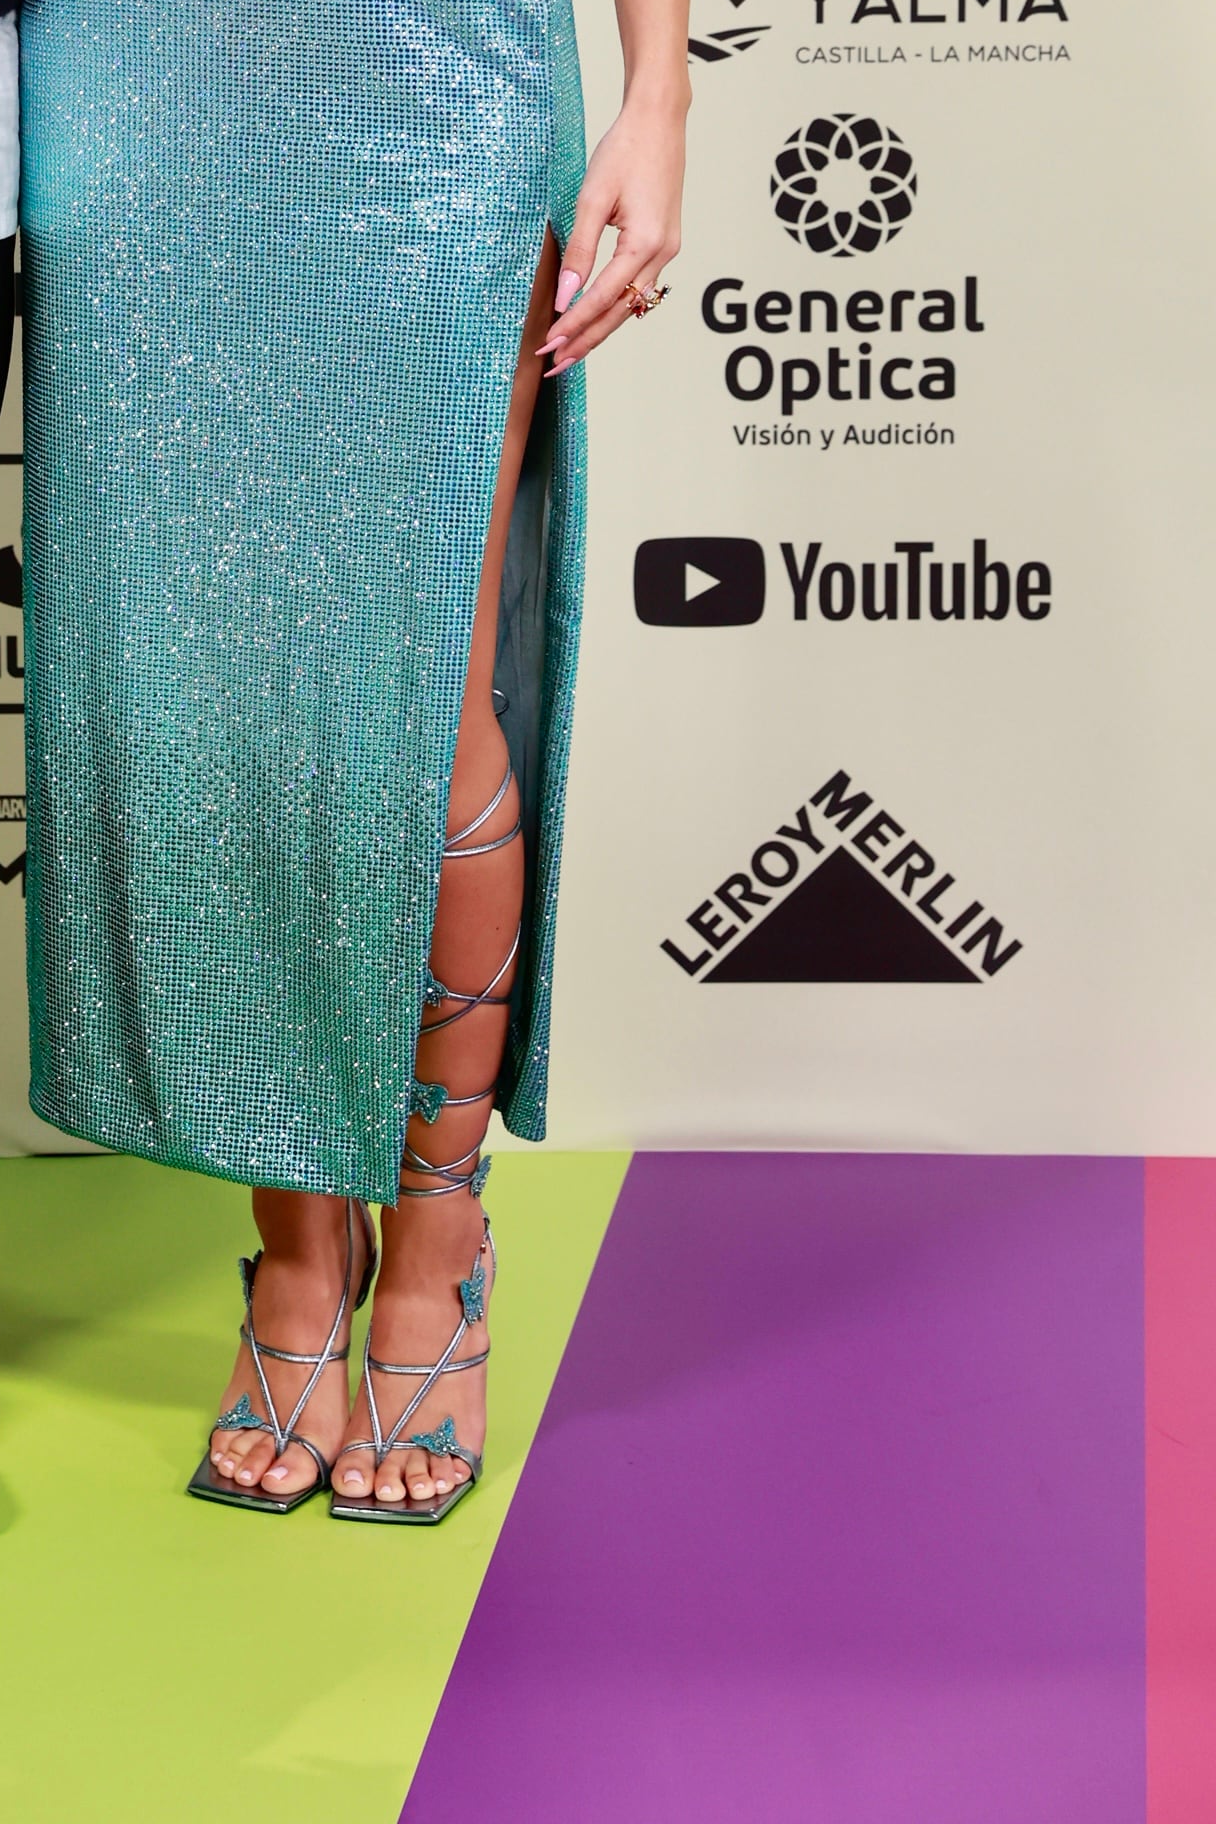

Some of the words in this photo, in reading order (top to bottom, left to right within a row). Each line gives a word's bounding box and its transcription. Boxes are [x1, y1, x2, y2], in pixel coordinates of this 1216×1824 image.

[795, 46, 907, 64] CASTILLA
[930, 46, 960, 63] LA
[968, 44, 1071, 62] MANCHA
[701, 277, 985, 334] General
[724, 341, 956, 416] Optica
[733, 423, 811, 446] Visión
[821, 429, 835, 451] y
[843, 422, 955, 446] Audición
[779, 539, 1052, 622] YouTube
[659, 804, 826, 977] LEROY
[808, 769, 1024, 978] MERLIN
